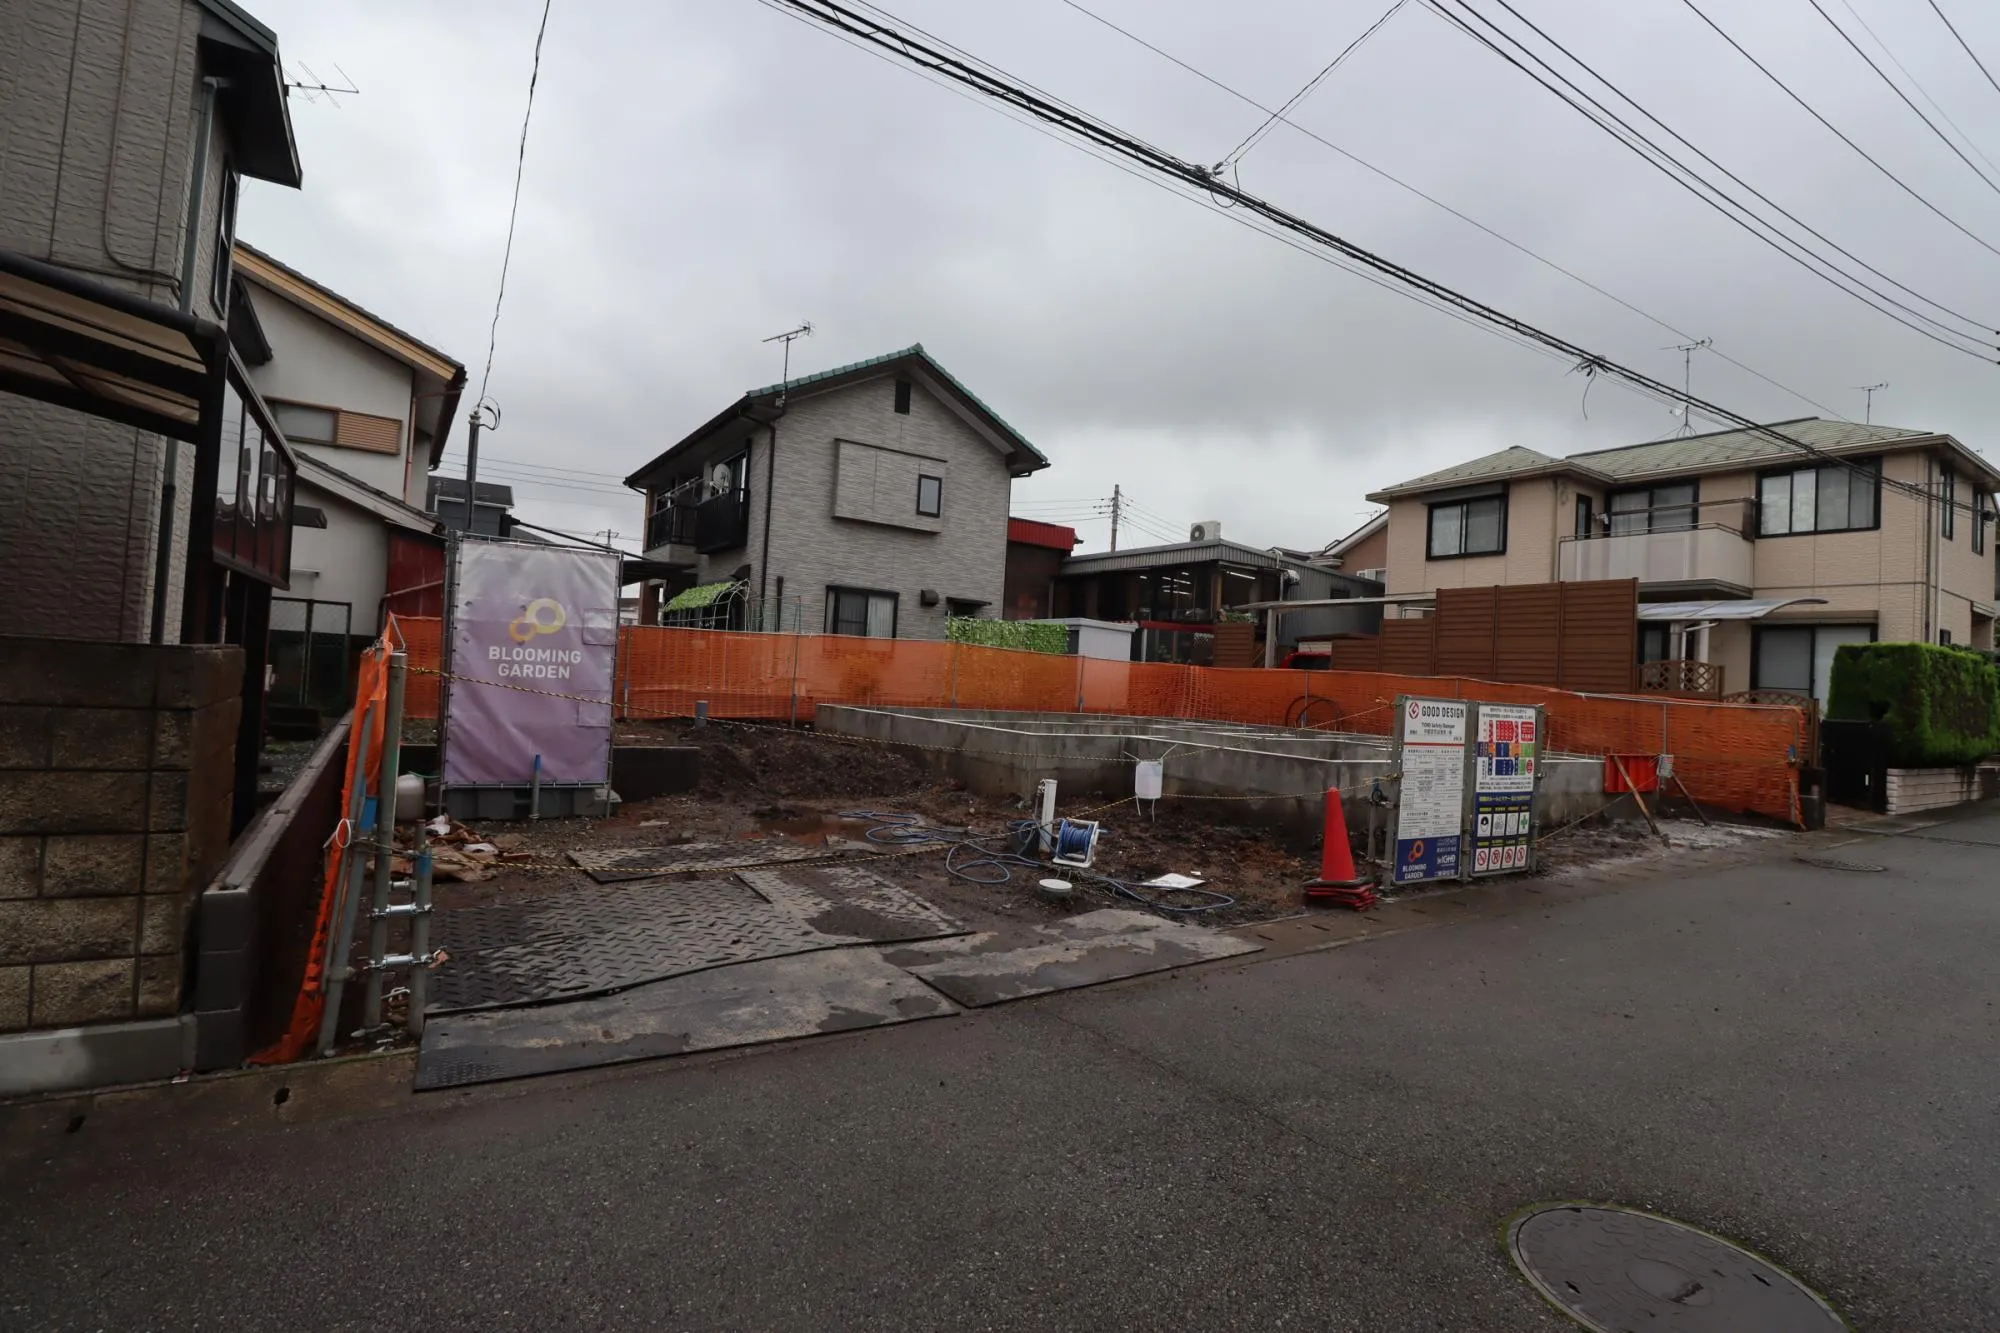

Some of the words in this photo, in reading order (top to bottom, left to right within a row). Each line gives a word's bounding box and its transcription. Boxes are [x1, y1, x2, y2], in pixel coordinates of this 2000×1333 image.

[488, 646, 581, 664] BLOOMING
[498, 663, 570, 679] GARDEN
[1421, 705, 1440, 717] GOOD
[1442, 706, 1465, 718] DESIGN
[1402, 864, 1427, 872] BLOOMING
[1404, 871, 1424, 880] GARDEN
